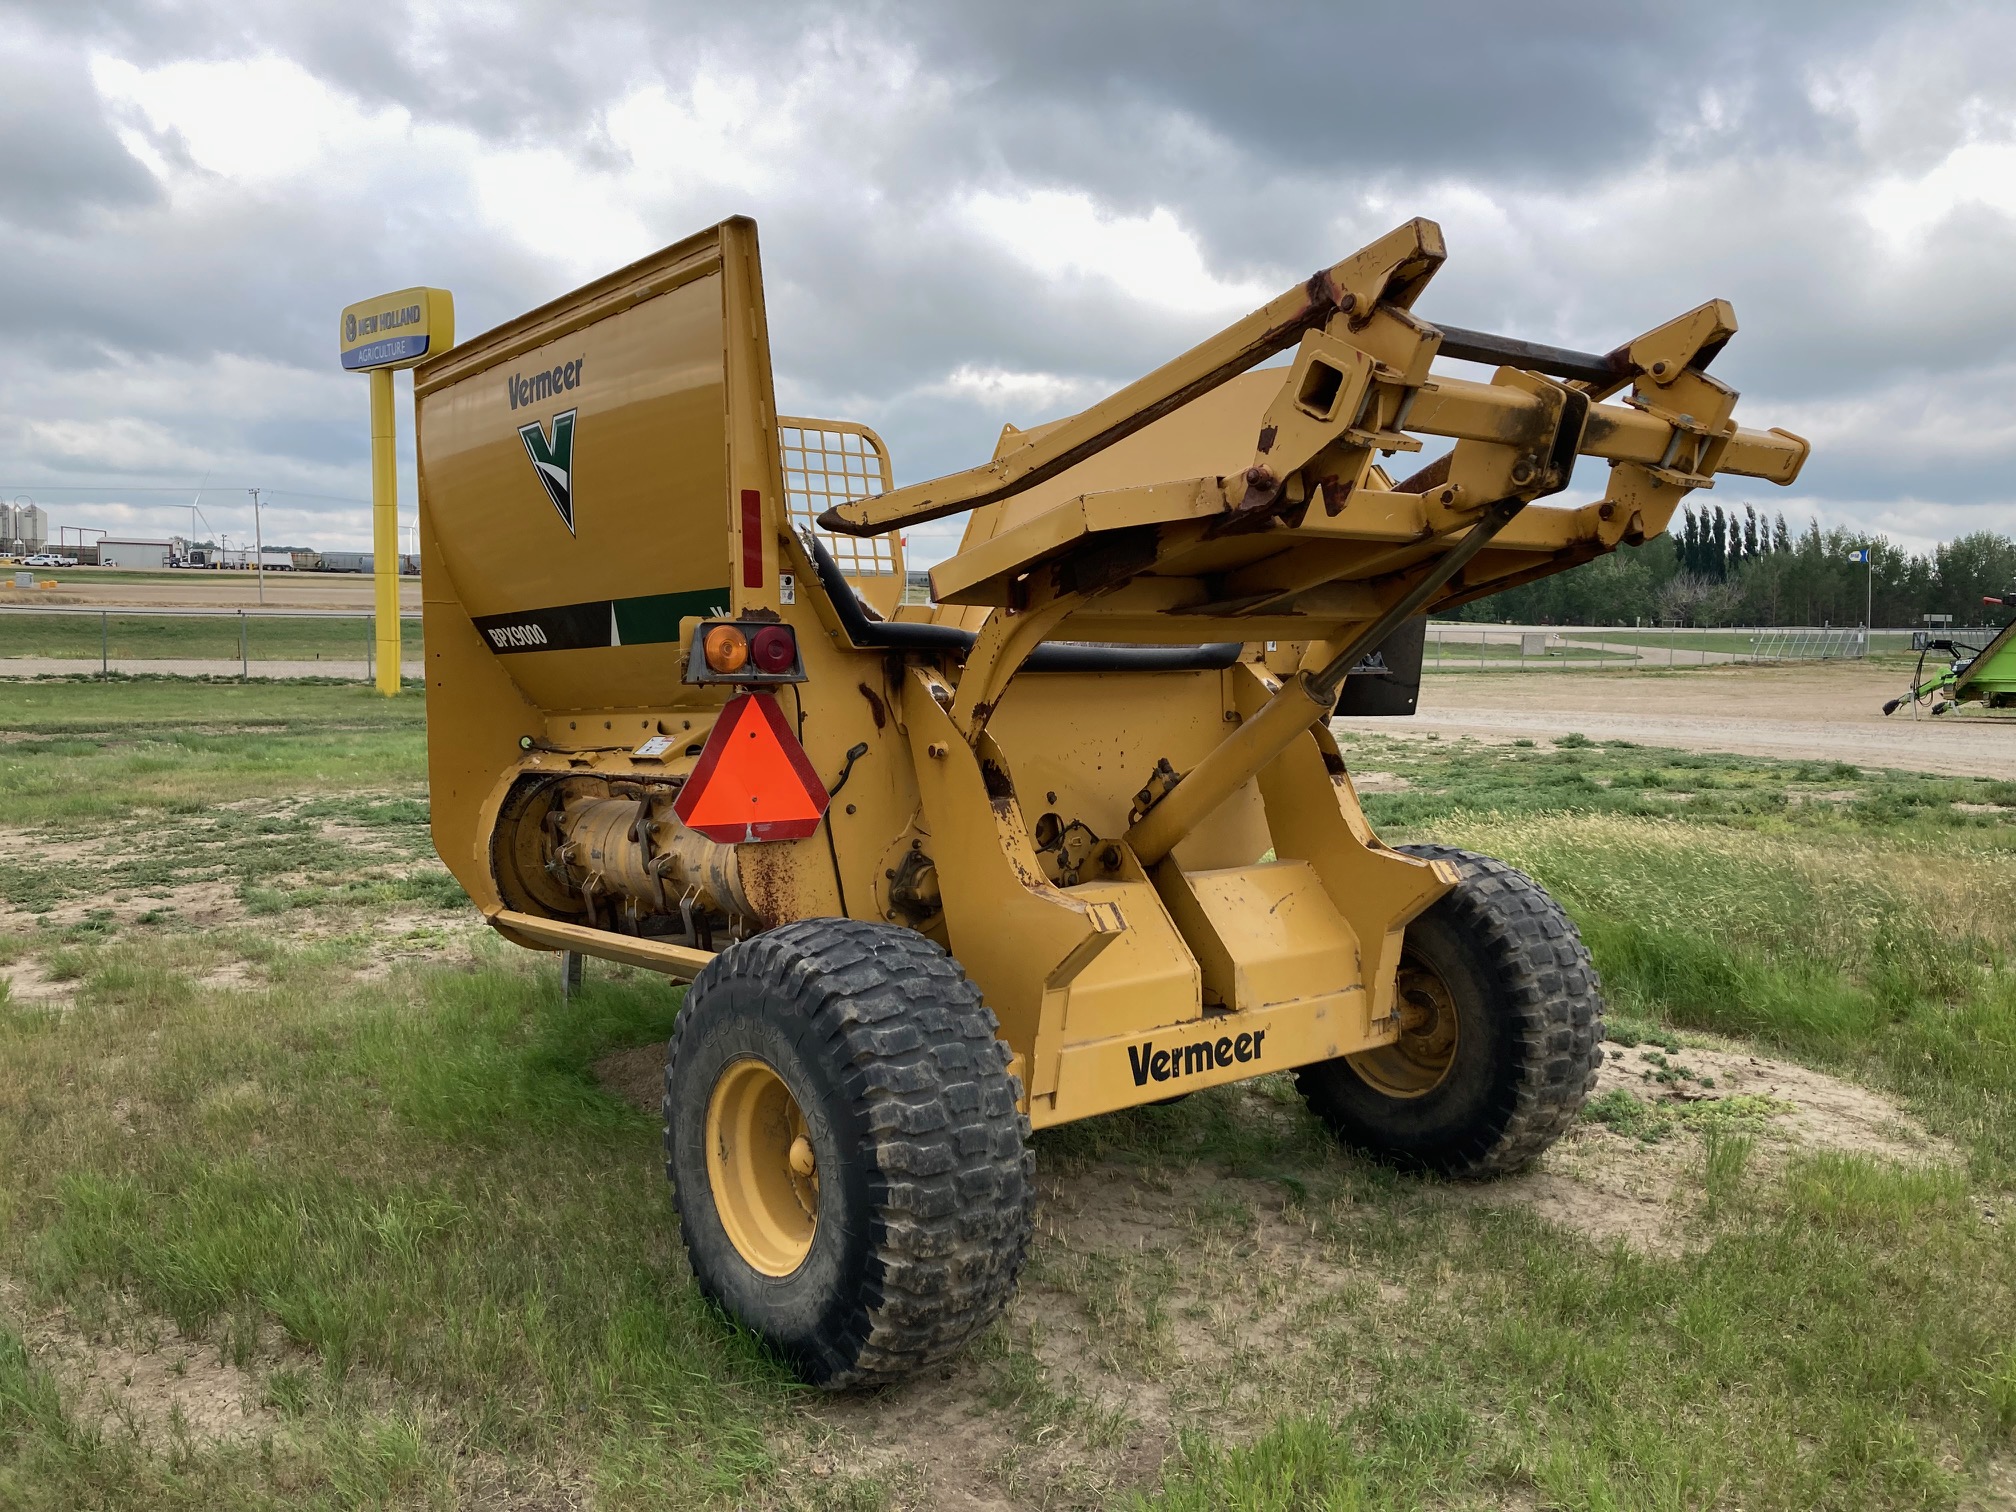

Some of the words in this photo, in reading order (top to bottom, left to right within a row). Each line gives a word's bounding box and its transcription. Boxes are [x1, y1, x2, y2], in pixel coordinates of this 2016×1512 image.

[358, 315, 378, 336] NEW
[380, 305, 420, 331] HOLLAND
[358, 340, 406, 363] AGRICULTURE
[508, 357, 583, 411] Vermeer
[488, 623, 547, 648] BPX9000
[1127, 1029, 1265, 1087] Vermeer
